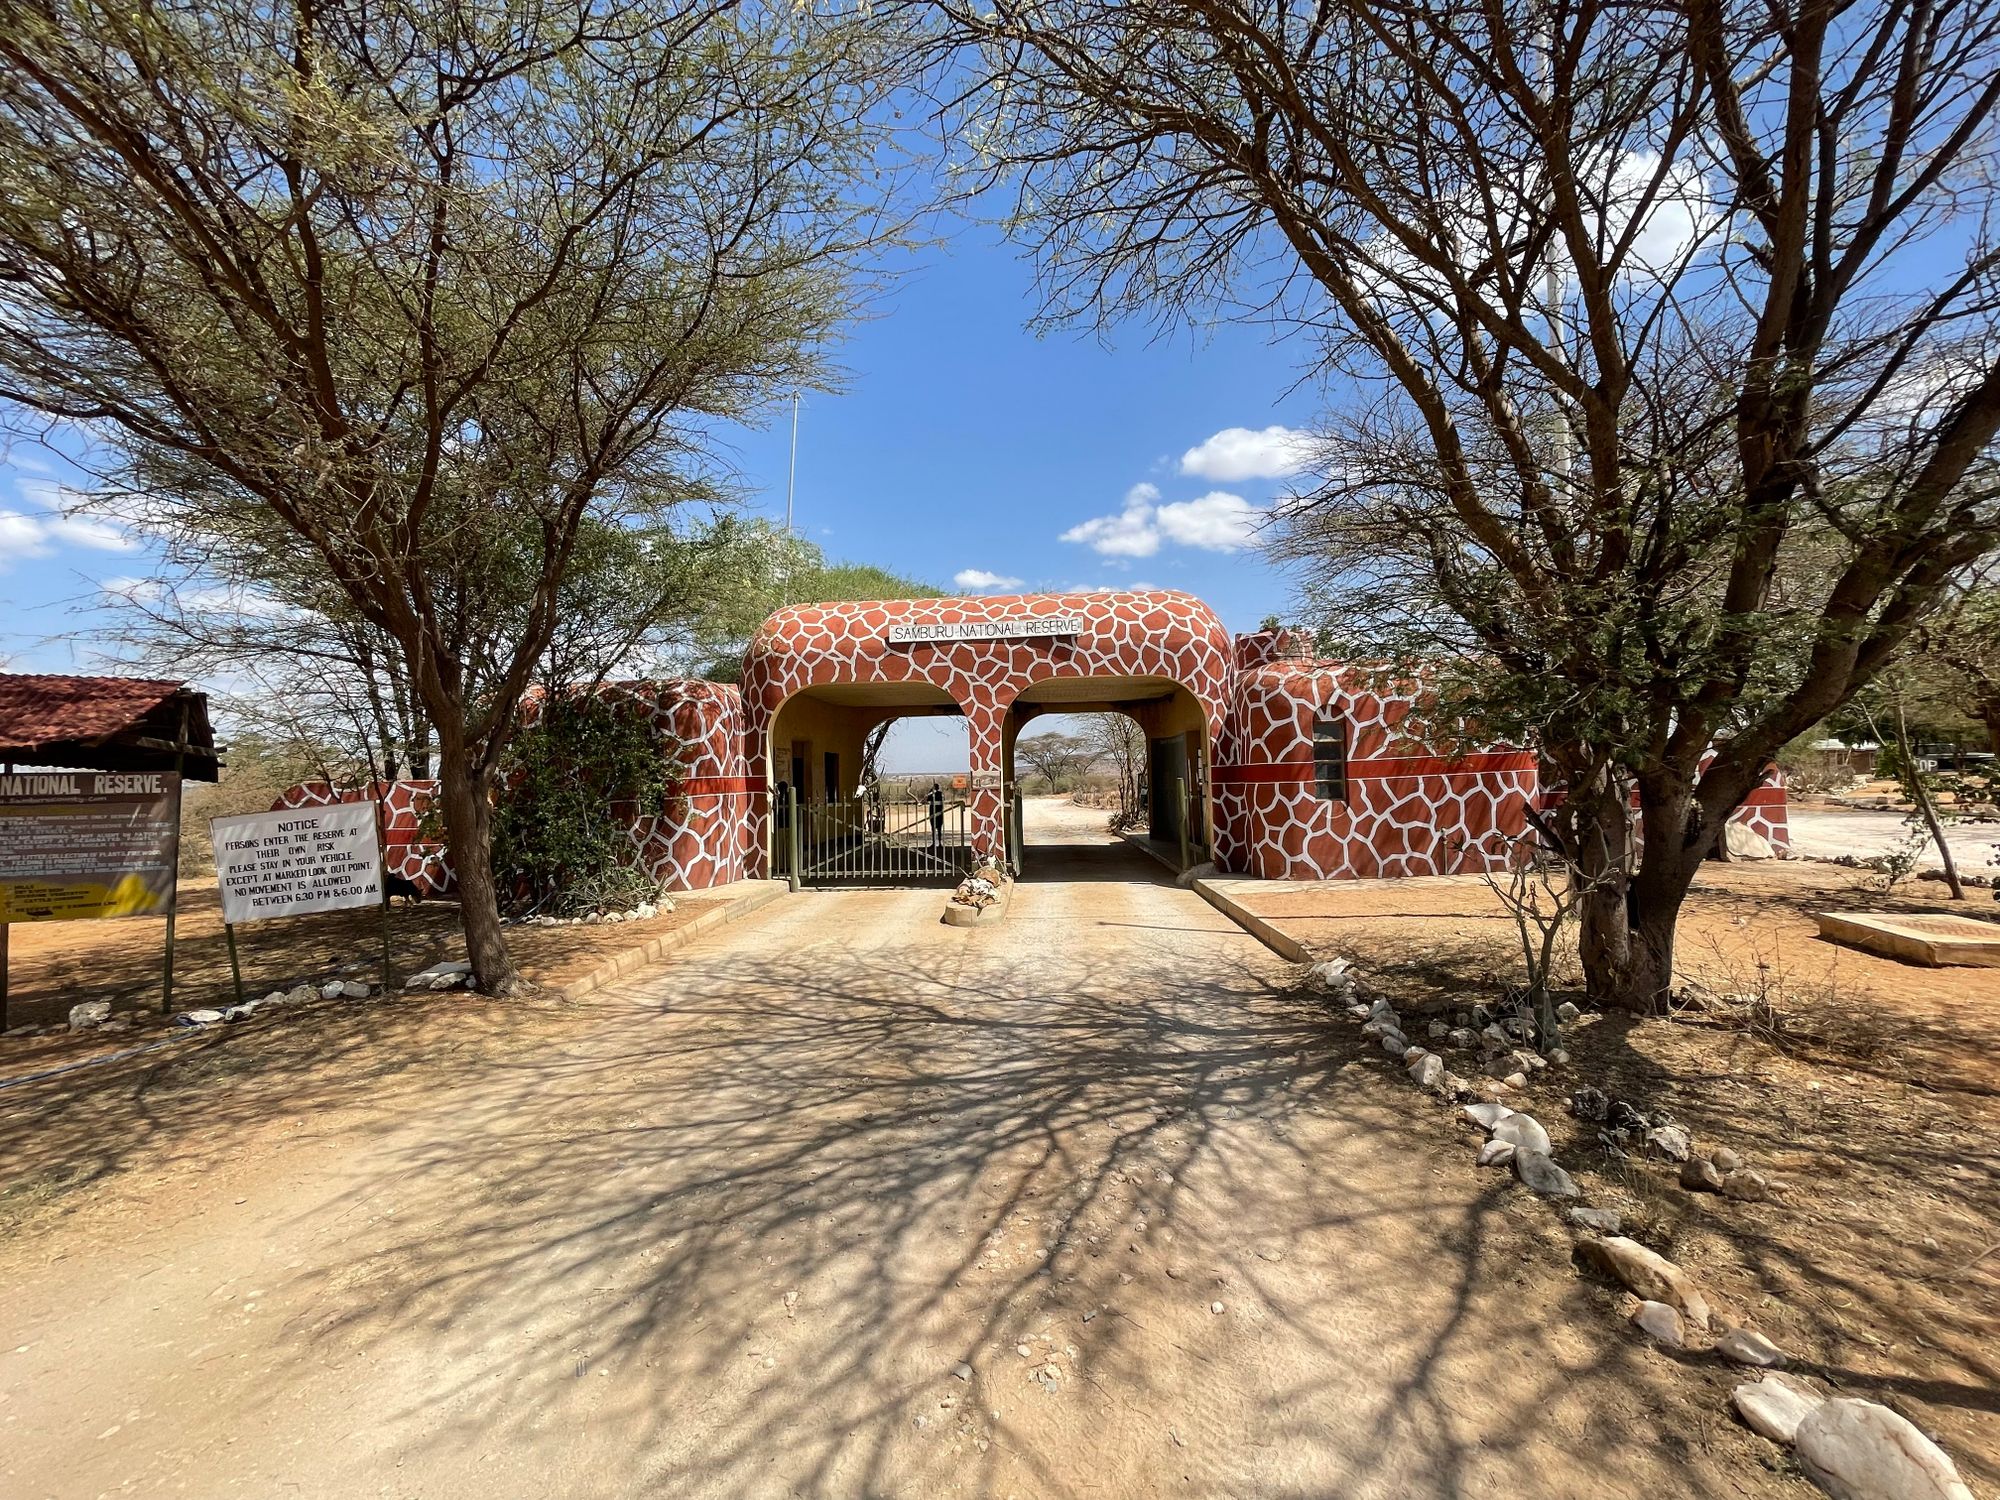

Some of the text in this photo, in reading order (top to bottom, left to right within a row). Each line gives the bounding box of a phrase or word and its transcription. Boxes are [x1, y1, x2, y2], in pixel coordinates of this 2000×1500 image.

[895, 619, 1079, 640] SAMBURU NATIONAL RESERVE
[0, 774, 168, 796] NATIONAL RESERVE.
[278, 819, 319, 832] NOTICE
[225, 828, 358, 850] PERSONS ENTER THE RESERVE AT
[256, 842, 335, 859] THEIR OWN RISK
[226, 862, 373, 886] EXCEPT AT MARKED LOOK OUT POINT.
[229, 863, 257, 874] PLEASE
[260, 861, 279, 870] STAY
[282, 859, 291, 868] IN
[295, 856, 316, 866] YOUR
[234, 876, 351, 897] NO MOVEMENT IS ALLOWED
[252, 895, 293, 907] BETWEEN
[295, 892, 314, 902] 6.30
[317, 890, 330, 899] PM
